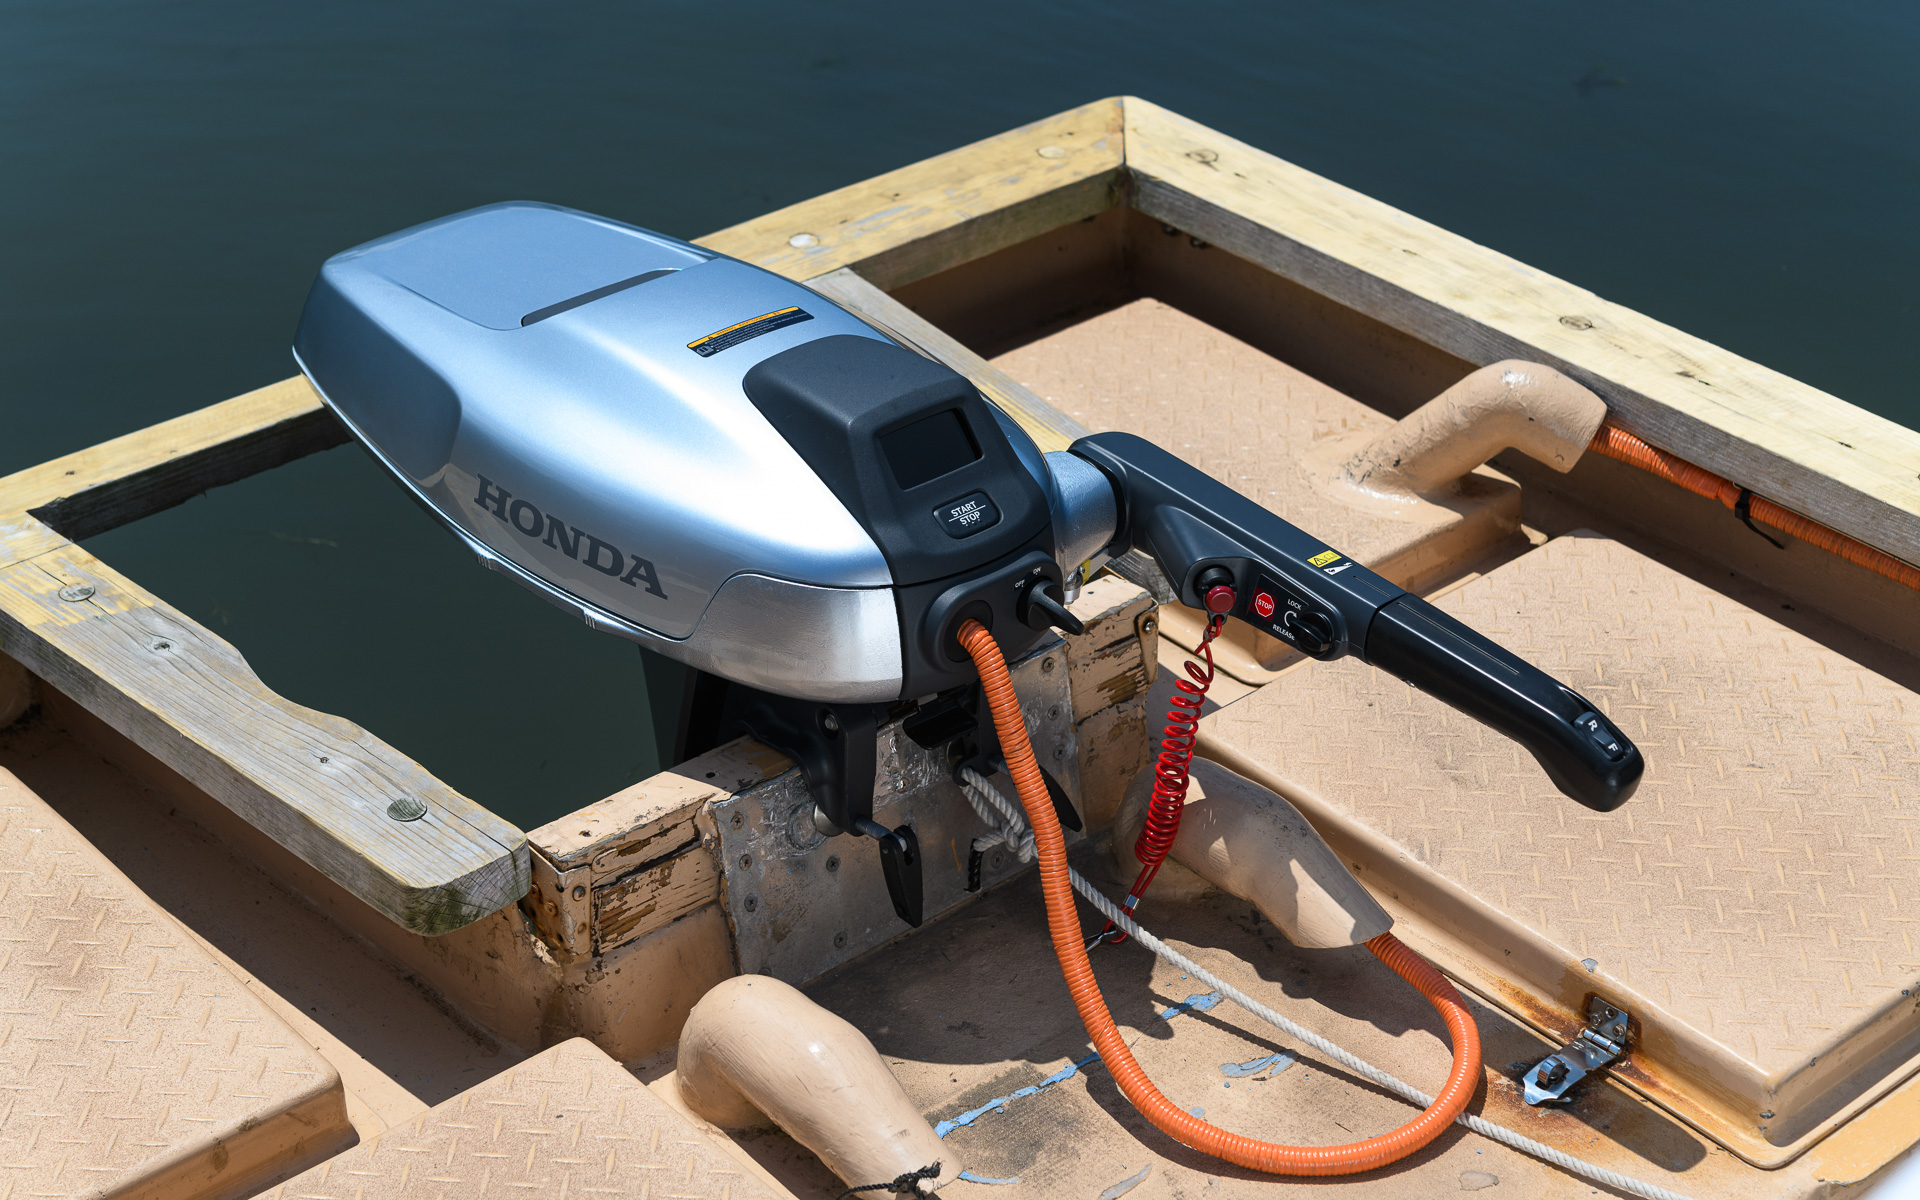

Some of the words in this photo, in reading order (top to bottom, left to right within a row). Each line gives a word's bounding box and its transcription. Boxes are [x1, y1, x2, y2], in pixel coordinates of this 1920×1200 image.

[951, 501, 977, 517] START
[959, 511, 981, 525] STOP
[473, 473, 668, 600] HONDA
[1257, 599, 1273, 610] STOP
[1287, 598, 1302, 611] LOCK
[1588, 720, 1598, 731] R
[1608, 743, 1618, 751] F
